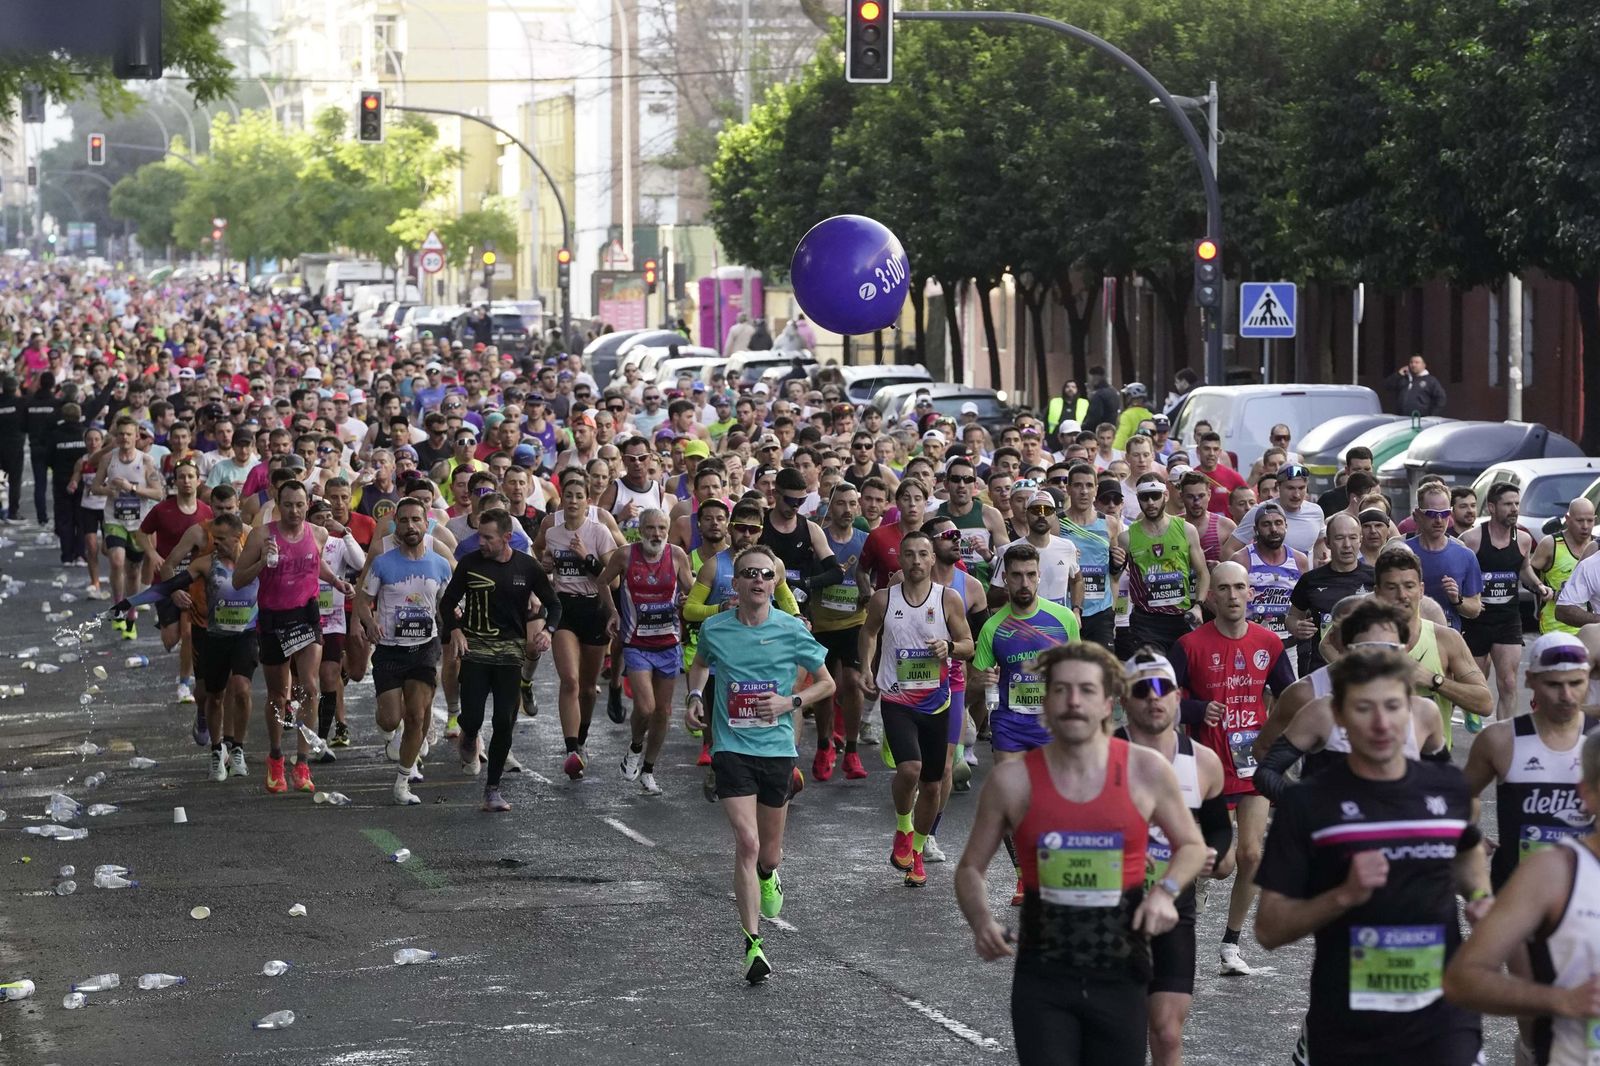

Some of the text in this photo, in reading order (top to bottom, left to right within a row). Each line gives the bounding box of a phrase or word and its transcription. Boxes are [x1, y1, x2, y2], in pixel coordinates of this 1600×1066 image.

[875, 253, 905, 294] 3:00
[559, 567, 580, 576] CLARA
[1151, 588, 1182, 600] YASSINE
[1490, 588, 1508, 597] TONY
[401, 628, 425, 637] MANUÉ
[906, 671, 931, 680] JUANI
[1015, 696, 1044, 705] ANDRE
[1066, 836, 1114, 847] ZURICH
[1062, 873, 1097, 887] SAM
[1384, 930, 1437, 945] ZURICH
